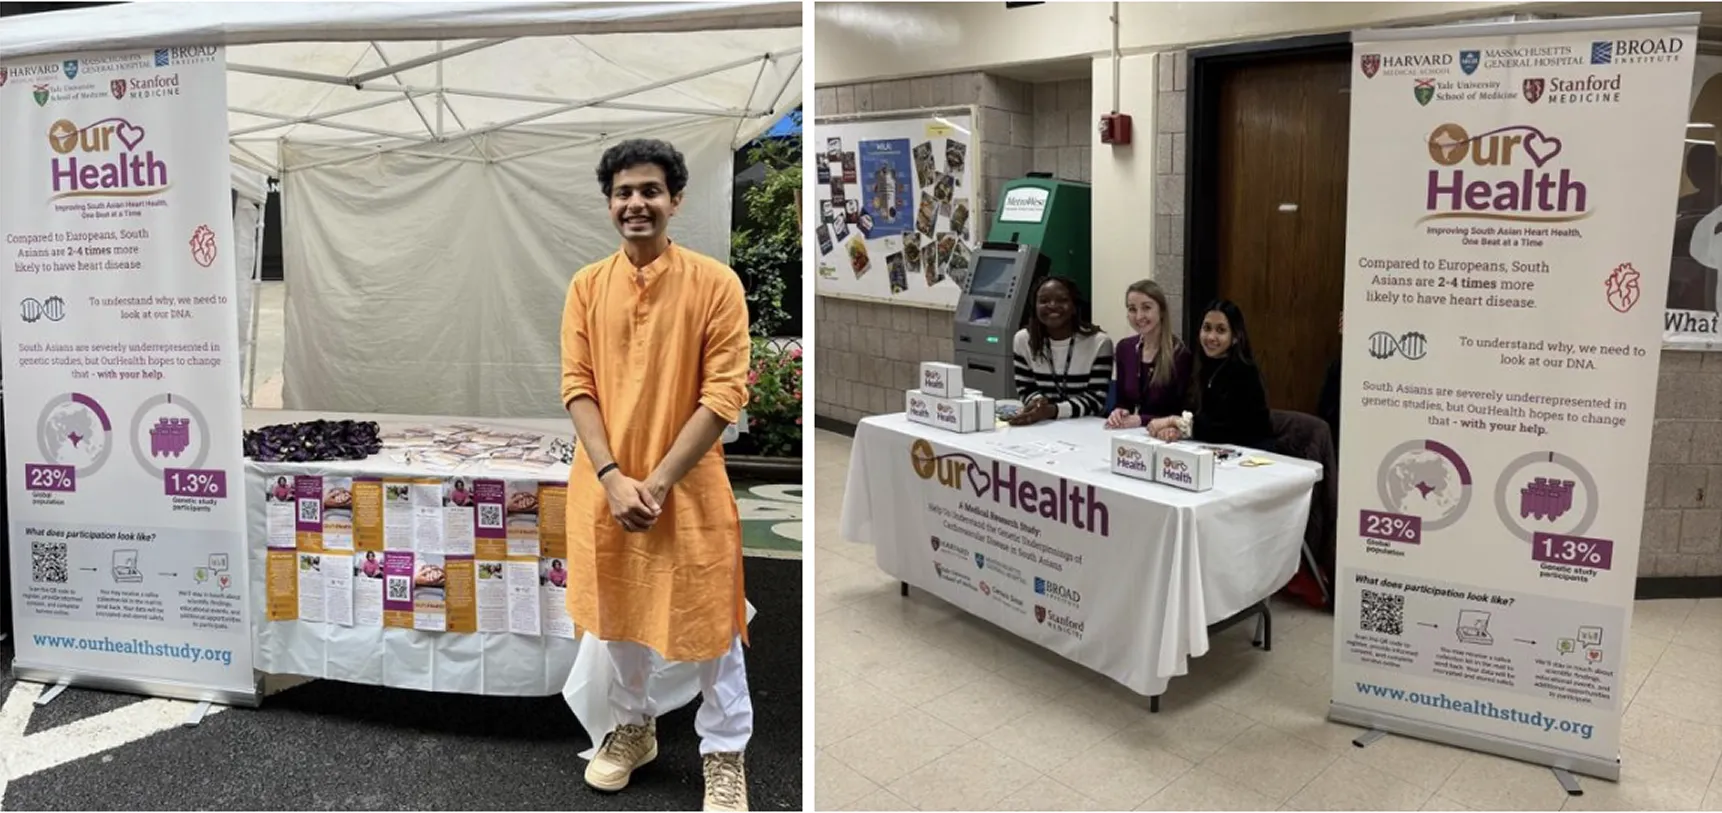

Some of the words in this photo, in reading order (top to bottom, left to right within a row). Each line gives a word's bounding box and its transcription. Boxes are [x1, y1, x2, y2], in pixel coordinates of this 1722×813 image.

[1484, 46, 1572, 58] MASSACHUSETTS
[1616, 38, 1683, 56] BROAD
[1383, 54, 1453, 67] HARVARD
[1484, 58, 1532, 69] GENERAL
[1534, 56, 1584, 66] HOSPITAL
[1615, 55, 1679, 64] INSTITUTE
[10, 65, 59, 78] HARVARD
[129, 74, 179, 89] Stanford
[1457, 81, 1500, 89] University
[1550, 74, 1621, 92] Stanford
[129, 88, 180, 99] MEDICINE
[1436, 92, 1464, 101] School
[1479, 90, 1517, 99] Medicine
[1549, 92, 1620, 104] MEDICINE
[49, 119, 115, 154] Our
[1428, 123, 1522, 166] Our
[51, 151, 168, 192] Health
[1427, 169, 1587, 212] Health
[6, 233, 53, 245] Compared
[66, 231, 118, 242] Europeans,
[119, 229, 149, 240] South
[1427, 226, 1469, 236] Improving
[1471, 227, 1495, 235] South
[1497, 227, 1522, 235] Asian
[1524, 228, 1548, 236] Heart
[1551, 228, 1582, 238] Health,
[1462, 237, 1478, 245] One
[1481, 238, 1500, 246] Beat
[1502, 238, 1511, 246] at
[1521, 238, 1543, 247] Time
[18, 248, 49, 257] Asians
[51, 248, 65, 256] are
[67, 246, 82, 256] 2-4
[85, 246, 111, 255] times
[113, 245, 139, 254] more
[14, 262, 39, 274] likely
[42, 262, 52, 272] to
[54, 262, 76, 271] have
[78, 260, 102, 271] heart
[1358, 257, 1420, 271] Compared
[1423, 260, 1435, 270] to
[1438, 259, 1508, 273] Europeans,
[1511, 261, 1549, 273] South
[1372, 275, 1413, 286] Asians
[1415, 278, 1434, 287] are
[1437, 277, 1458, 288] 2-4
[1462, 278, 1496, 289] times
[1500, 280, 1534, 291] more
[89, 297, 100, 306] To
[102, 295, 153, 306] understand
[155, 295, 176, 306] why,
[178, 296, 190, 304] we
[193, 294, 217, 304] need
[218, 296, 227, 304] to
[1366, 291, 1399, 304] likely
[1403, 293, 1413, 303] to
[1416, 293, 1446, 305] have
[1450, 294, 1483, 306] heart
[1486, 296, 1537, 308] disease.
[121, 309, 140, 319] look
[142, 309, 151, 318] at
[1665, 312, 1719, 333] What
[1459, 336, 1473, 347] To
[1477, 338, 1544, 350] understand
[1547, 341, 1576, 354] why,
[1579, 344, 1597, 354] we
[1600, 345, 1630, 356] need
[1633, 346, 1646, 357] to
[1500, 354, 1526, 366] look
[1528, 356, 1540, 366] at
[1543, 358, 1563, 367] our
[72, 370, 89, 378] that
[97, 369, 117, 378] with
[119, 371, 140, 380] your
[1363, 381, 1393, 392] South
[1396, 384, 1433, 395] Asians
[1436, 388, 1453, 396] are
[1456, 389, 1503, 402] severely
[1506, 392, 1611, 409] underrepresented
[1614, 400, 1627, 410] in
[1361, 396, 1400, 407] genetic
[1402, 400, 1443, 411] studies,
[1447, 402, 1464, 412] but
[1467, 403, 1526, 418] OurHealth
[1529, 408, 1564, 421] hopes
[1567, 412, 1578, 422] to
[1582, 413, 1626, 427] change
[1428, 415, 1450, 426] that
[1460, 418, 1486, 430] with
[1489, 422, 1516, 432] your
[1519, 423, 1548, 436] help.
[1117, 458, 1146, 471] Health
[31, 469, 71, 488] 23%
[171, 473, 219, 493] 1.3%
[1163, 468, 1192, 484] Health
[992, 460, 1109, 537] Health
[965, 503, 988, 518] Medical
[26, 528, 45, 536] What
[46, 529, 65, 538] does
[66, 530, 116, 541] participation
[117, 531, 134, 540] look
[136, 532, 156, 542] like?
[1367, 515, 1415, 539] 23%
[1366, 539, 1391, 547] Global
[1541, 538, 1601, 564] 1.3%
[1366, 546, 1405, 557] population
[1539, 570, 1588, 582] participants
[1540, 562, 1572, 575] Genetic
[1573, 566, 1598, 577] study
[1047, 581, 1080, 602] BROAD
[1356, 574, 1378, 585] What
[1380, 578, 1402, 589] does
[1404, 582, 1465, 599] participation
[1467, 592, 1488, 603] look
[1491, 595, 1515, 606] like?
[1048, 610, 1084, 632] Stanford
[33, 633, 232, 665] www.ourhealthstudy.org
[1355, 682, 1594, 739] www.ourhealthstudy.org
